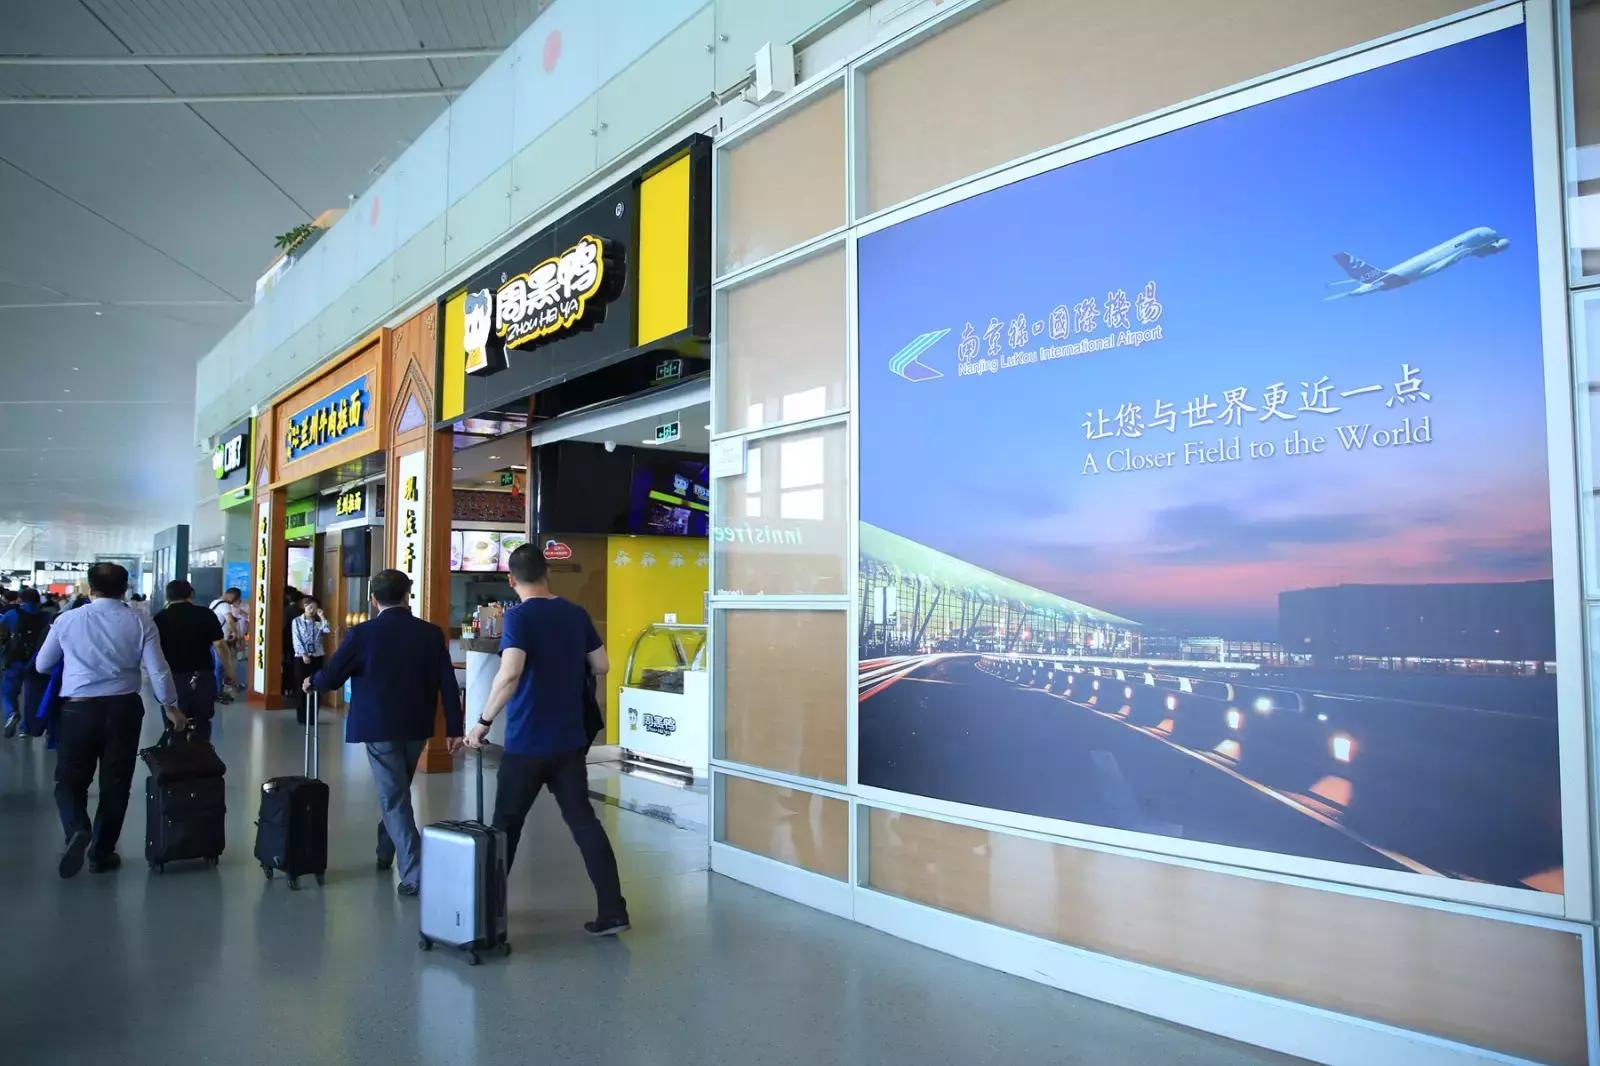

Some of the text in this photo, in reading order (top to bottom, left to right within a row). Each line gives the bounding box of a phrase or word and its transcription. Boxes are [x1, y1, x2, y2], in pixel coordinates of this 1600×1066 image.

[496, 241, 597, 329] 周黑鸭
[507, 299, 579, 341] ZHOU HEI YA
[958, 325, 1164, 377] Nanjing LuKou International Airport
[1081, 363, 1432, 441] 让您与世界更近一点
[1081, 416, 1433, 475] A Closer Field to the World
